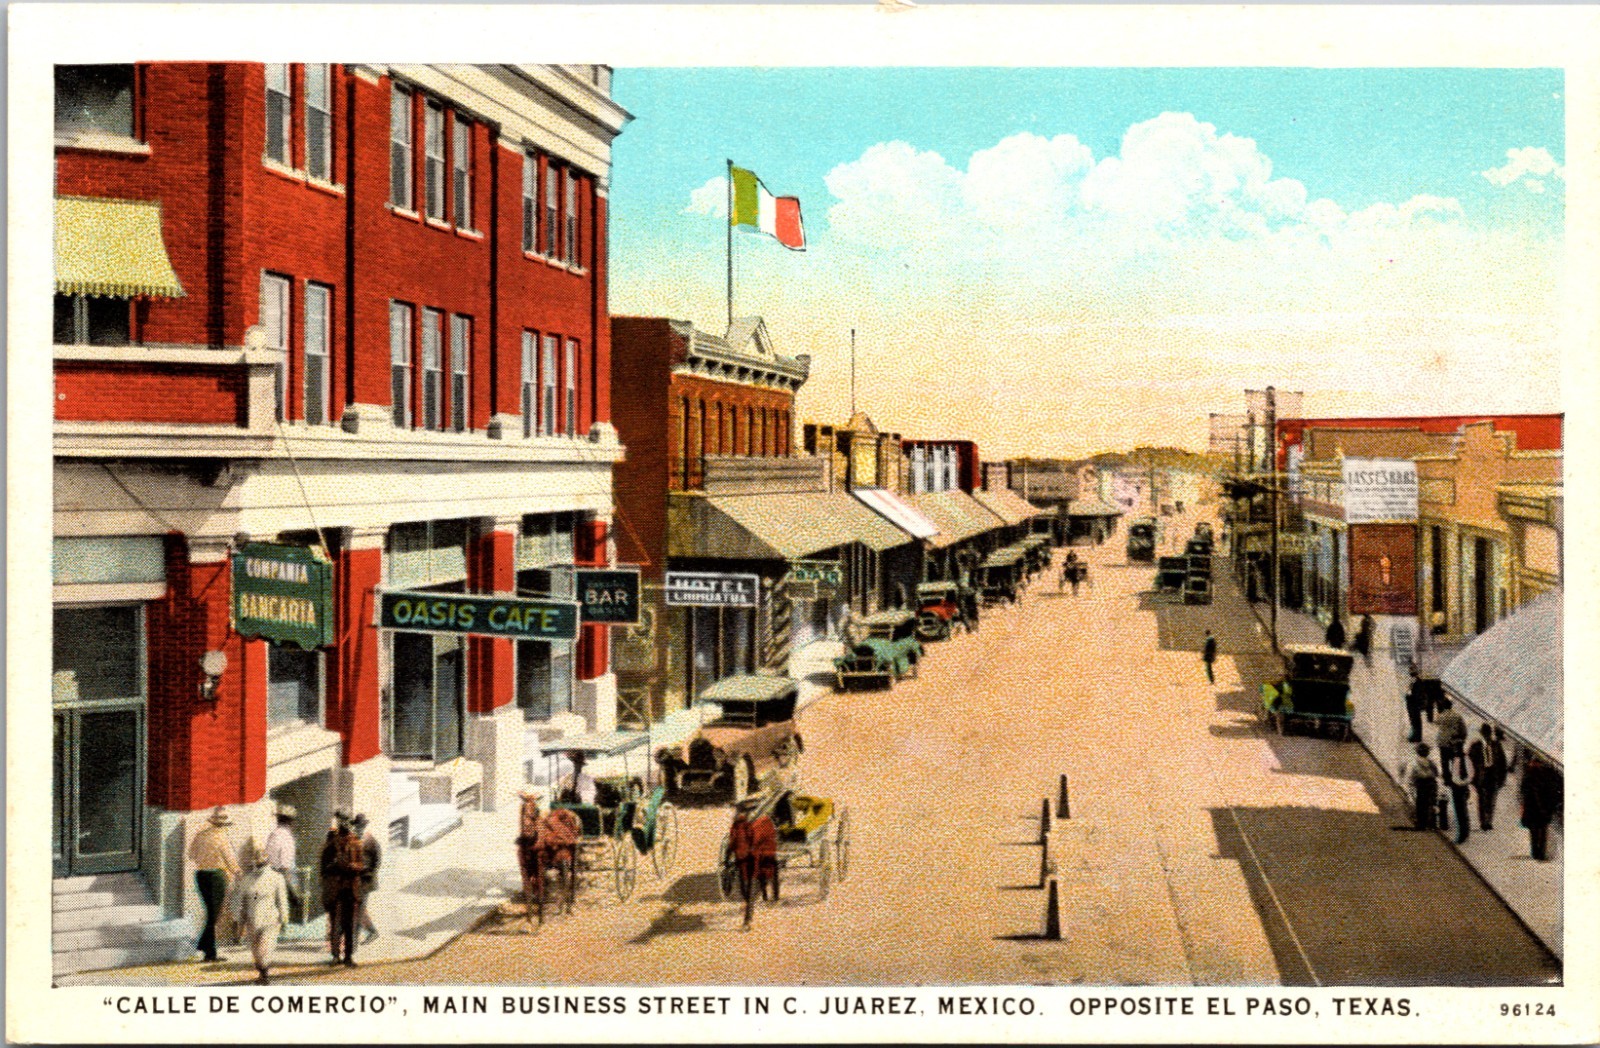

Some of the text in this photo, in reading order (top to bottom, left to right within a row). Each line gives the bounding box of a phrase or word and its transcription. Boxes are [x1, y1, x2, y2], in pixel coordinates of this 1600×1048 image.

[585, 589, 629, 605] BAR
[676, 579, 750, 594] HOTEL
[239, 592, 317, 629] BANCARIA
[392, 600, 561, 633] OASIS CAFE
